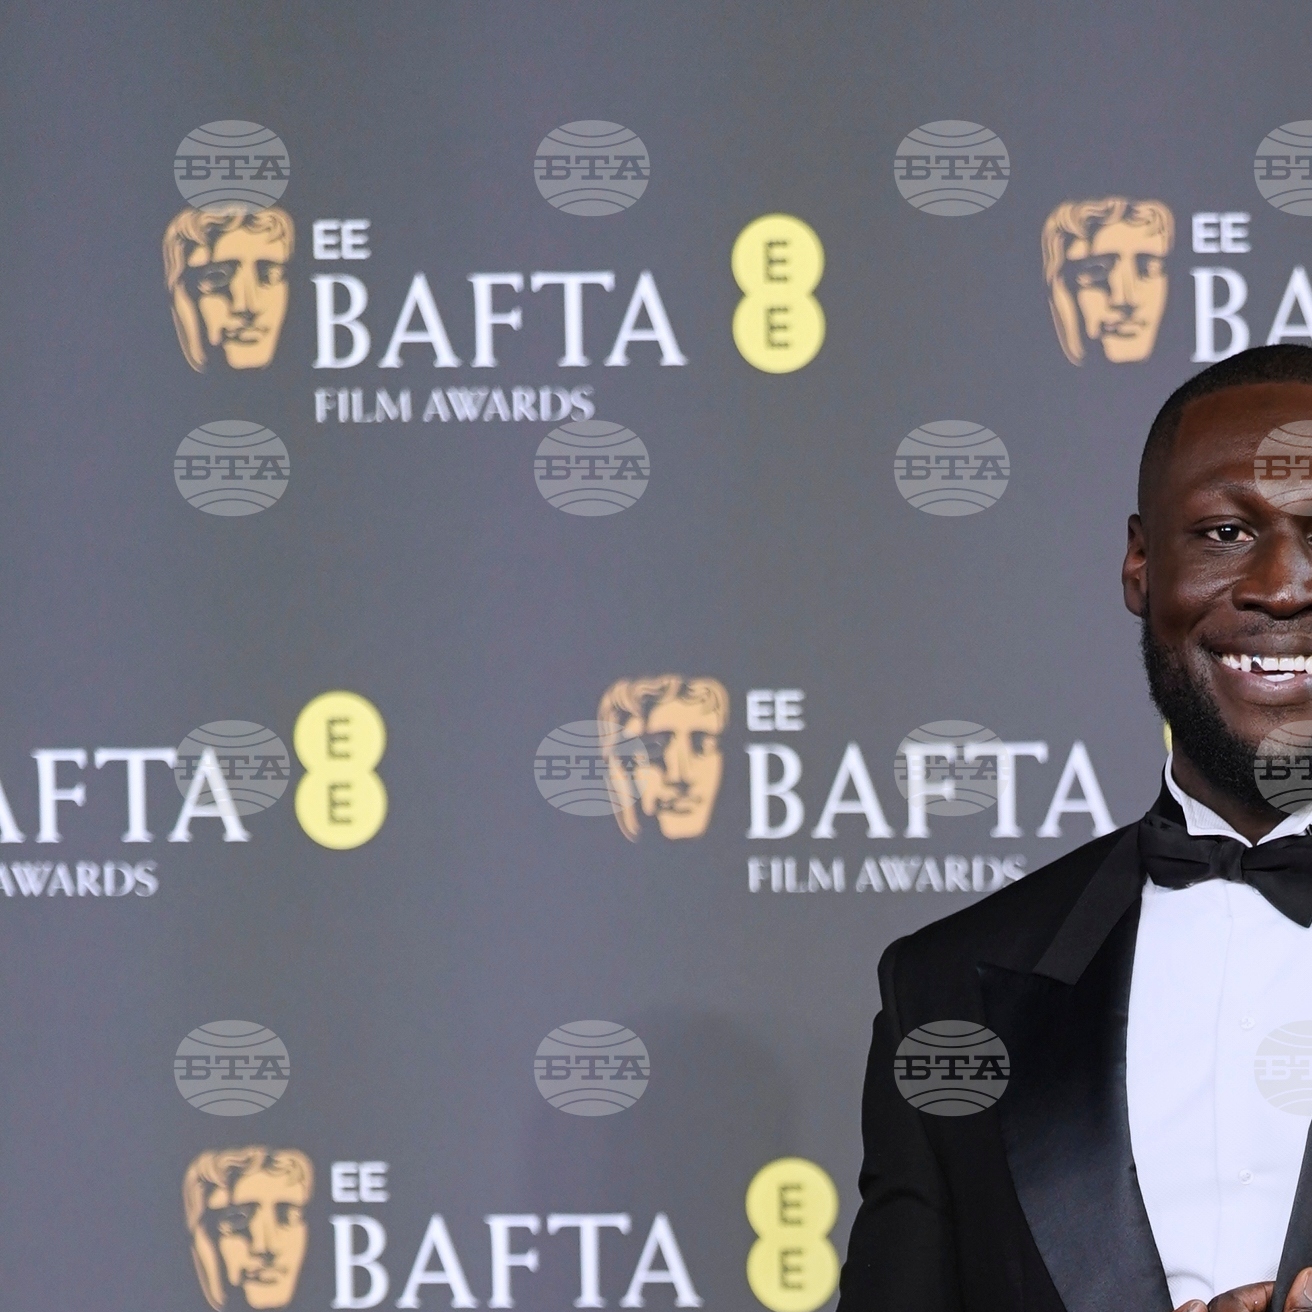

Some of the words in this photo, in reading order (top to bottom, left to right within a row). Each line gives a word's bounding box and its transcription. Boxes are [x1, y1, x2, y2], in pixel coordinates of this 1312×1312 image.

[313, 219, 370, 260] EE
[1192, 212, 1250, 253] EE
[312, 271, 686, 368] BAFTA
[315, 388, 412, 423] FILM
[423, 387, 595, 422] AWARDS
[747, 690, 804, 731] EE
[0, 747, 252, 843] FTA
[746, 741, 1117, 839] BAFTA
[748, 857, 845, 892] FILM
[856, 855, 1027, 893] AWARDS
[331, 1161, 388, 1202] EE
[331, 1214, 700, 1309] BAFTA
